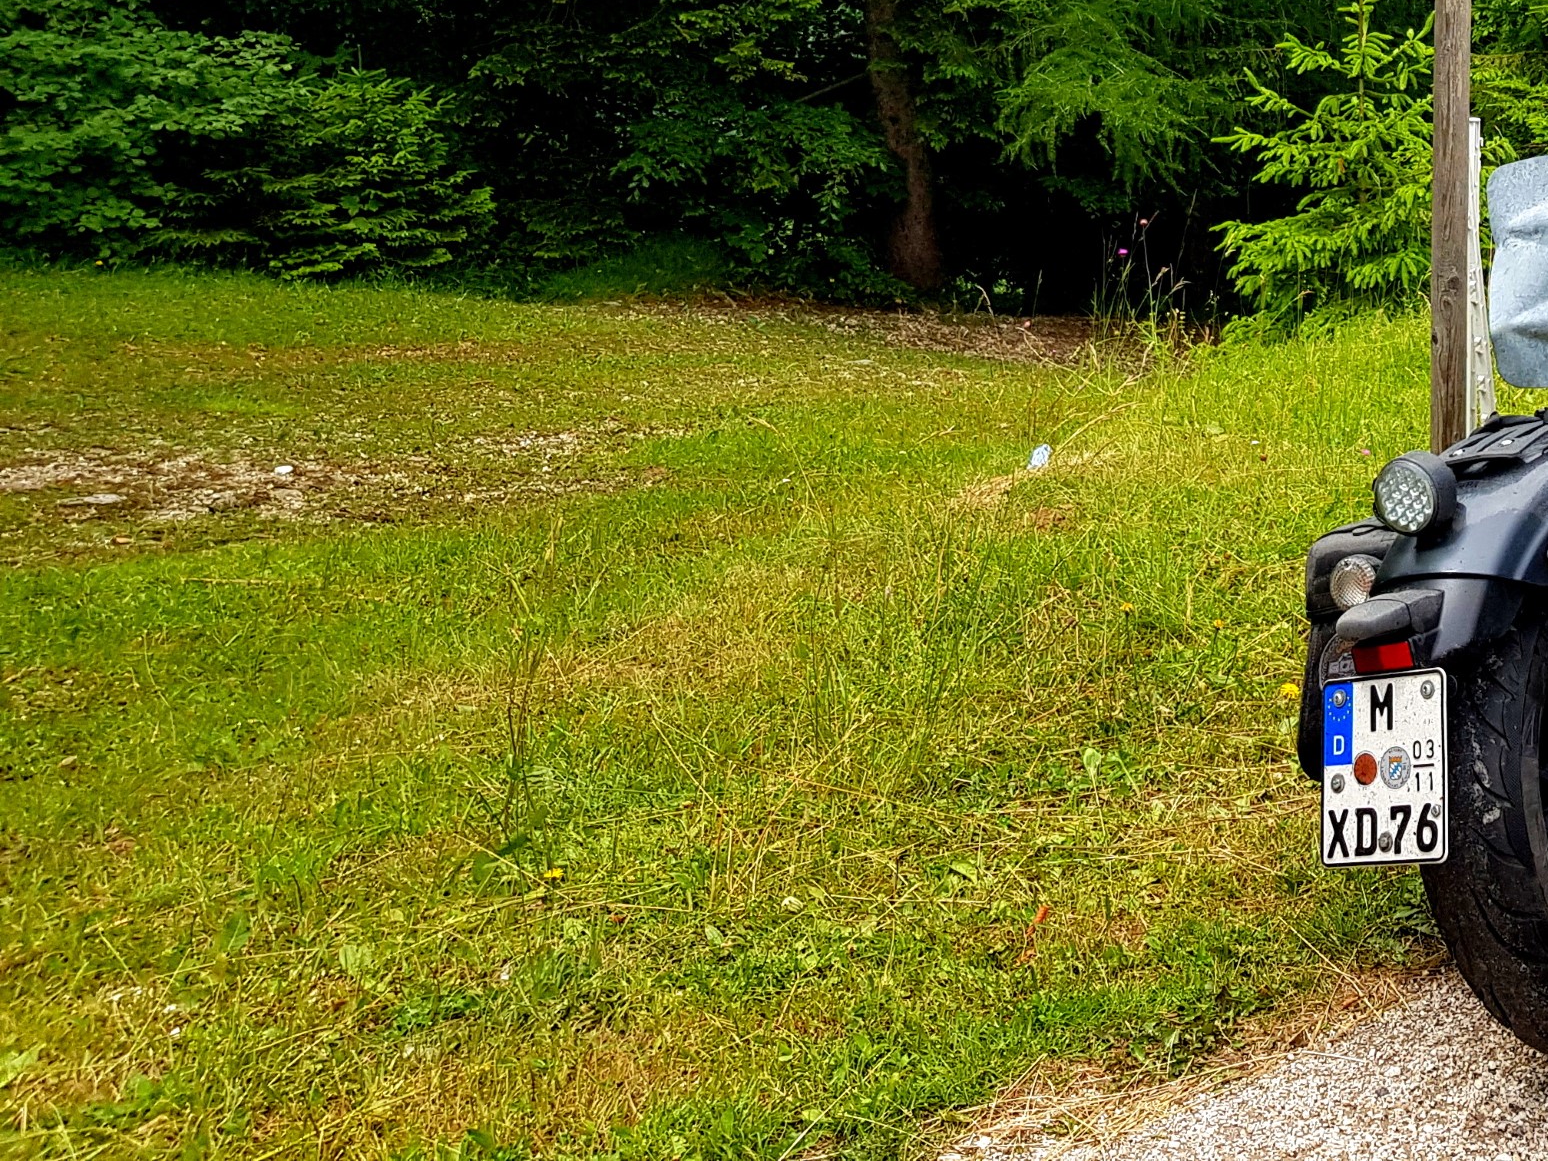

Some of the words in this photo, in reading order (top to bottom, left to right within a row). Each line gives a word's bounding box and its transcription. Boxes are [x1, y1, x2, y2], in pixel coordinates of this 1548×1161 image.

[1370, 682, 1394, 732] M
[1333, 734, 1345, 756] D
[1412, 739, 1435, 760] 03
[1414, 771, 1434, 792] 11
[1327, 807, 1378, 859] XD
[1390, 802, 1438, 854] 76
